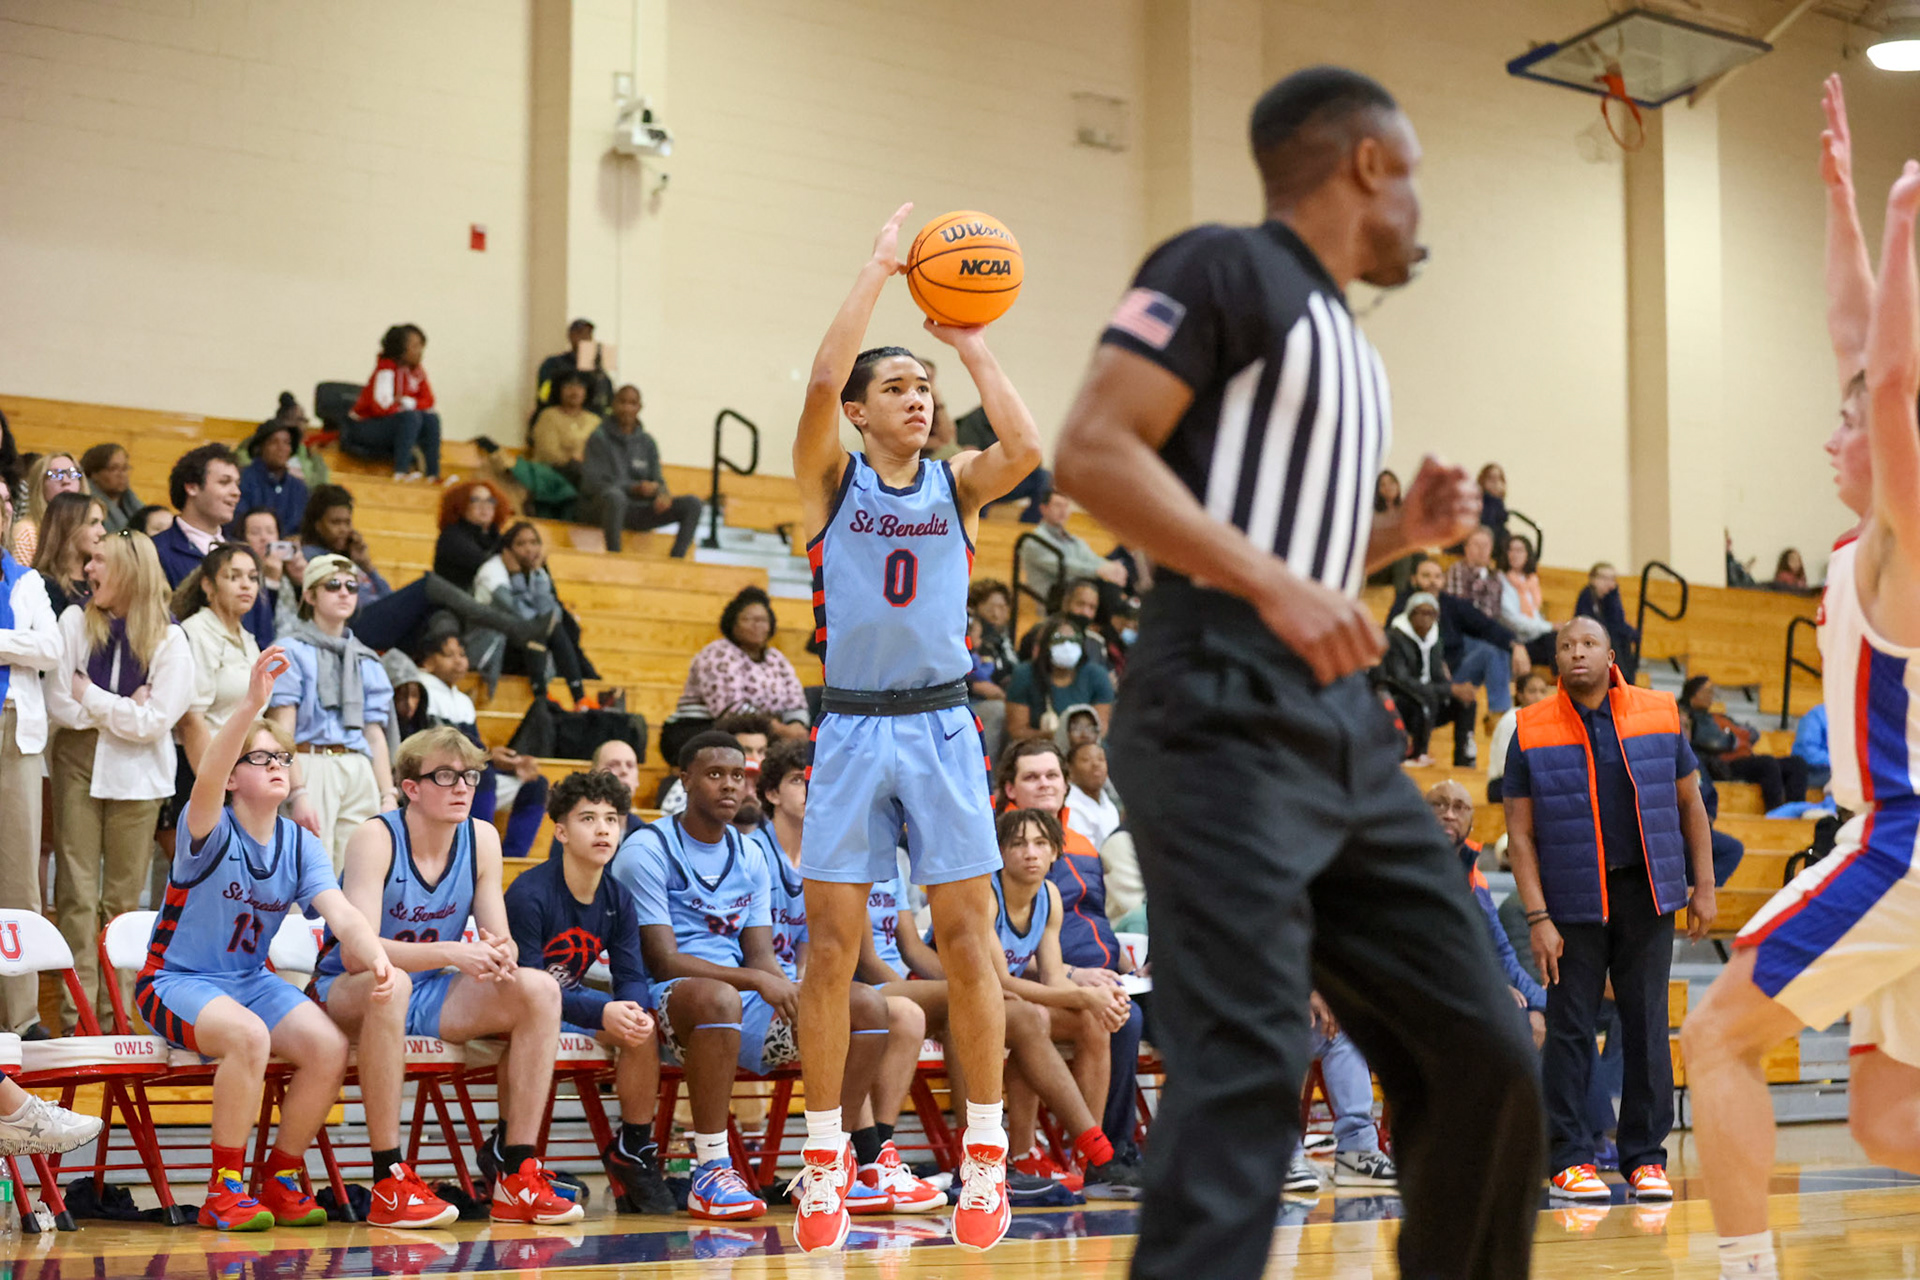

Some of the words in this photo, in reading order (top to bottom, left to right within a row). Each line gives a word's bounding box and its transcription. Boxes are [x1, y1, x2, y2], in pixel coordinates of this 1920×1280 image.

[940, 223, 1014, 243] Wilson
[959, 259, 1011, 276] NCAA
[849, 509, 875, 534] St
[876, 512, 949, 538] Benedict
[883, 548, 918, 608] 0
[222, 881, 244, 901] St
[389, 901, 408, 920] St
[407, 902, 456, 923] Benedict
[226, 912, 264, 954] 13
[114, 1041, 154, 1056] OWLS
[404, 1040, 444, 1054] WLS
[560, 1038, 594, 1051] WLS
